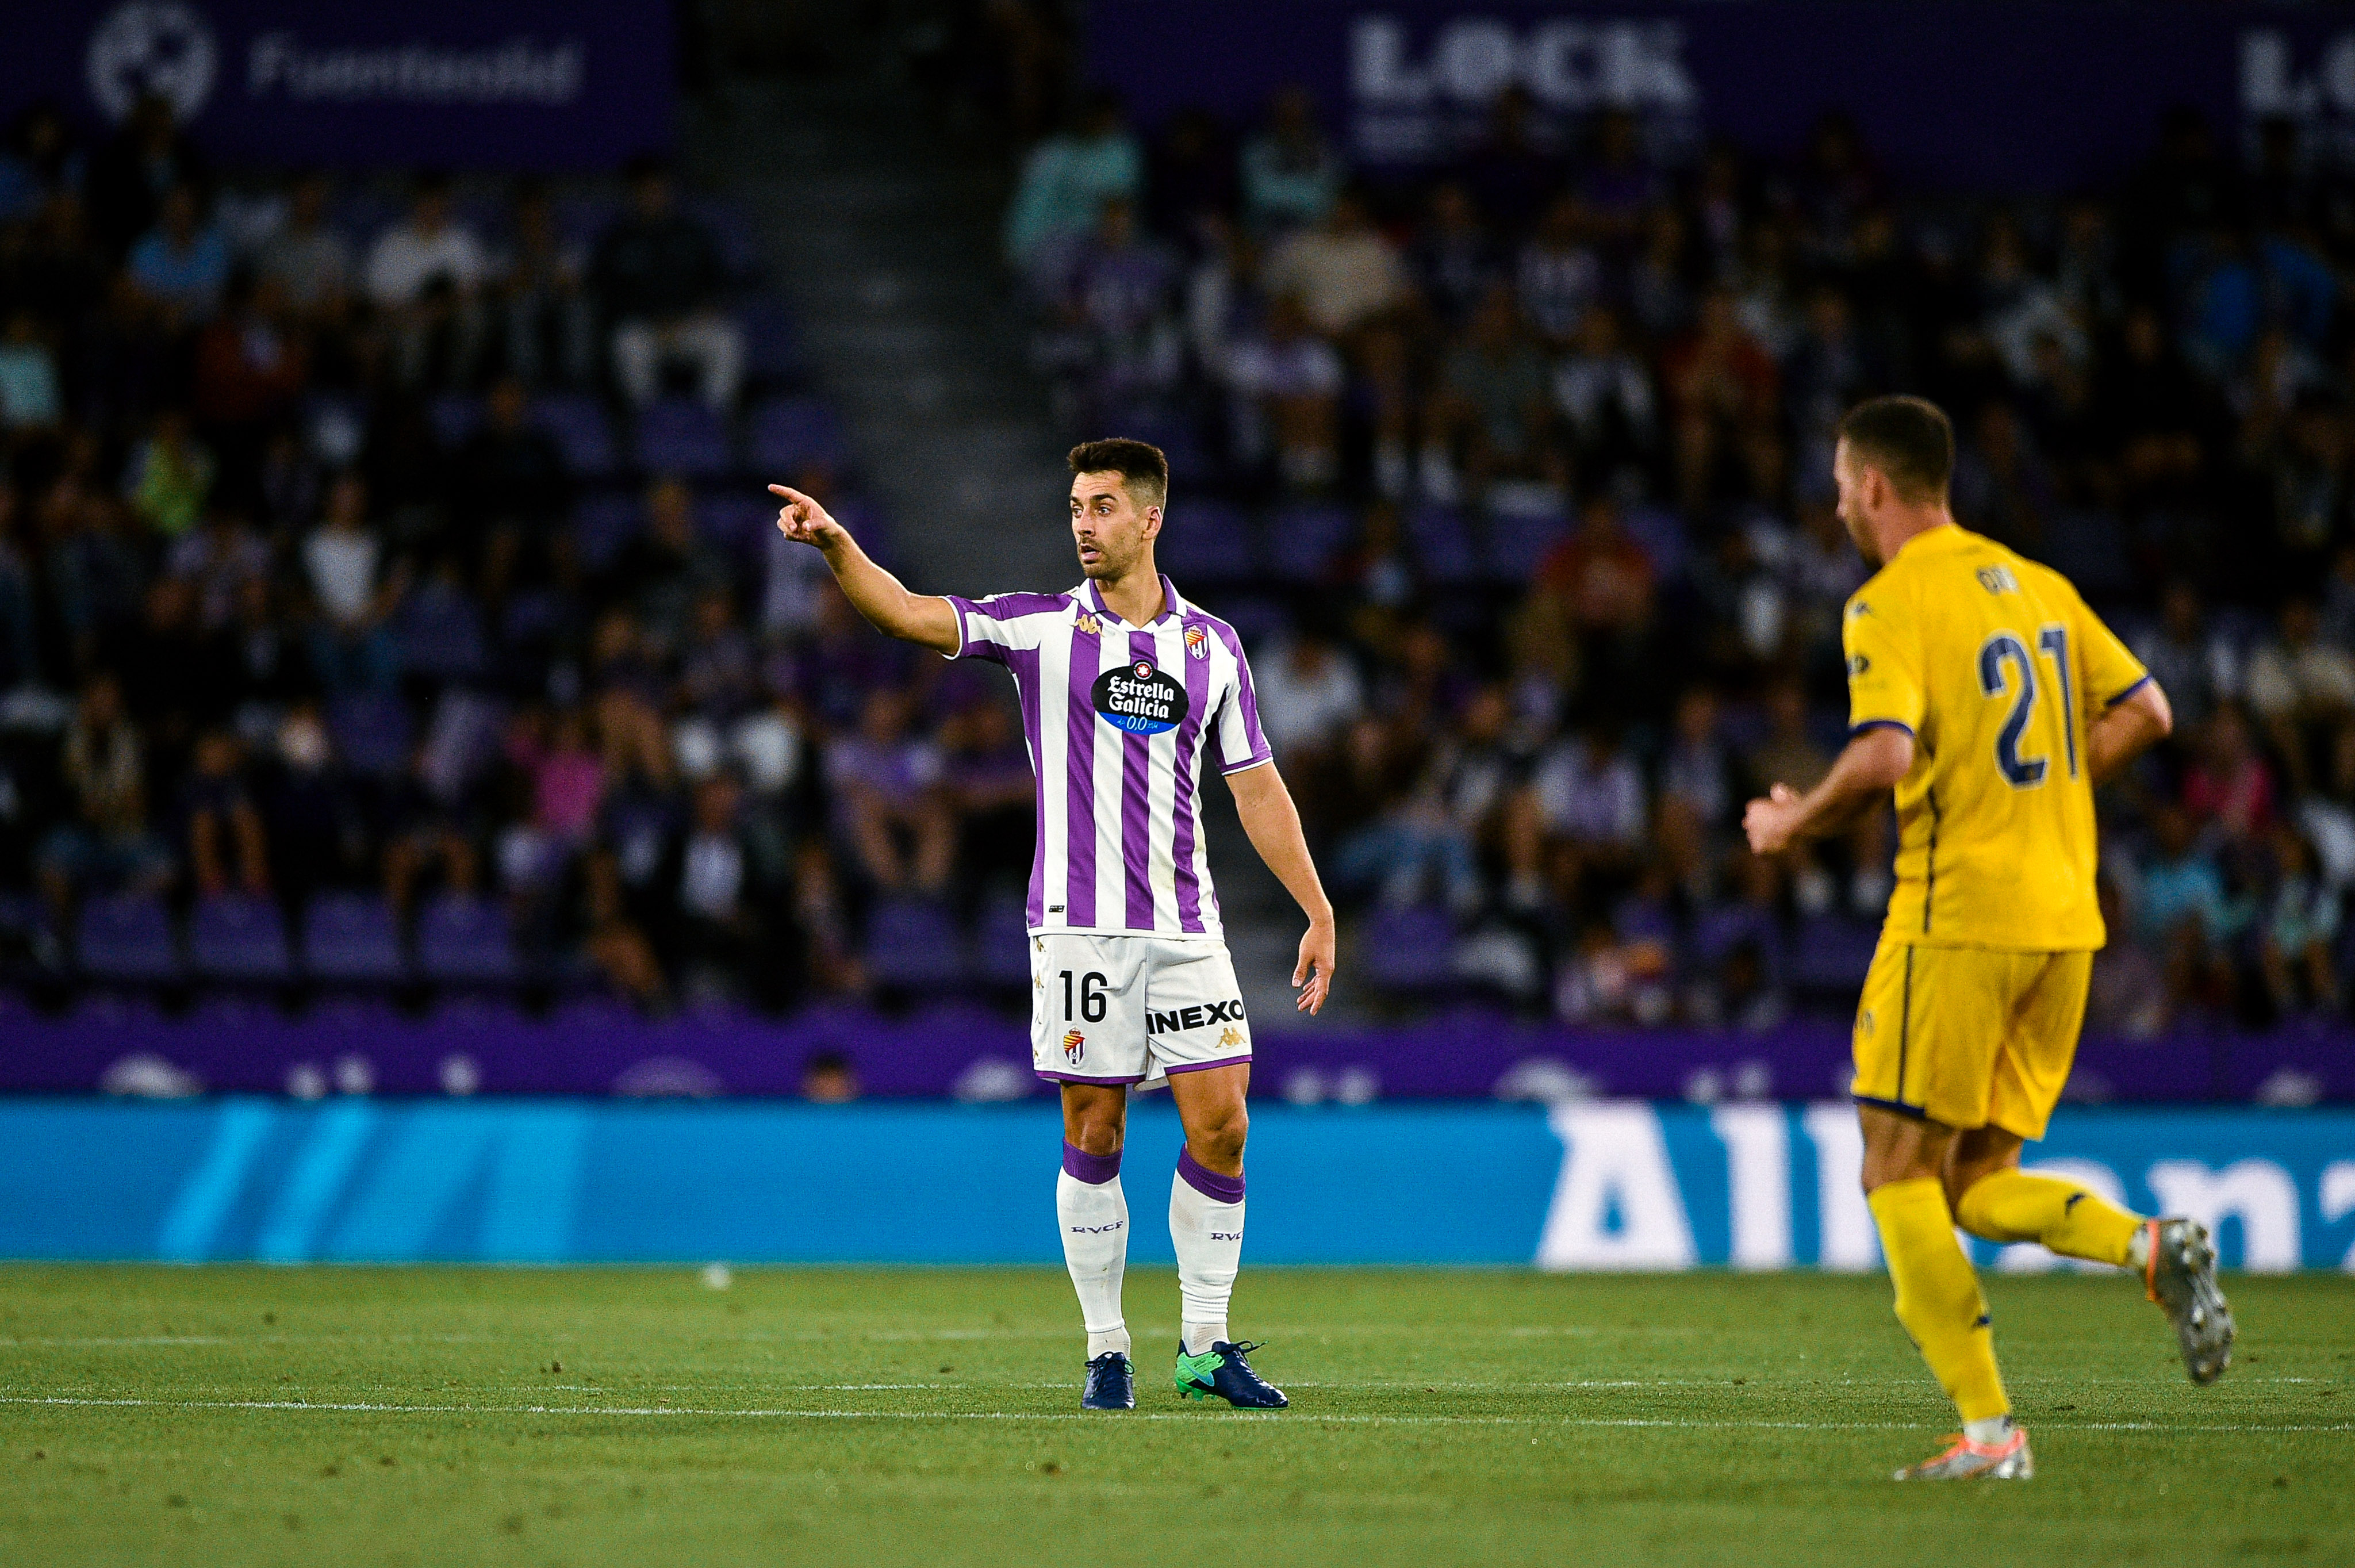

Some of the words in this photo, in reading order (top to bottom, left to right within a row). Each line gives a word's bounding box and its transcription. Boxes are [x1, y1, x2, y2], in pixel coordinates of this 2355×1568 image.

[1351, 17, 1697, 105] LOCK
[1107, 675, 1174, 701] Estrella
[1109, 692, 1169, 719] Galicia
[1977, 624, 2077, 789] 21
[1126, 715, 1148, 731] 0,0
[1058, 970, 1108, 1023] 16
[1071, 1220, 1124, 1234] RVCF
